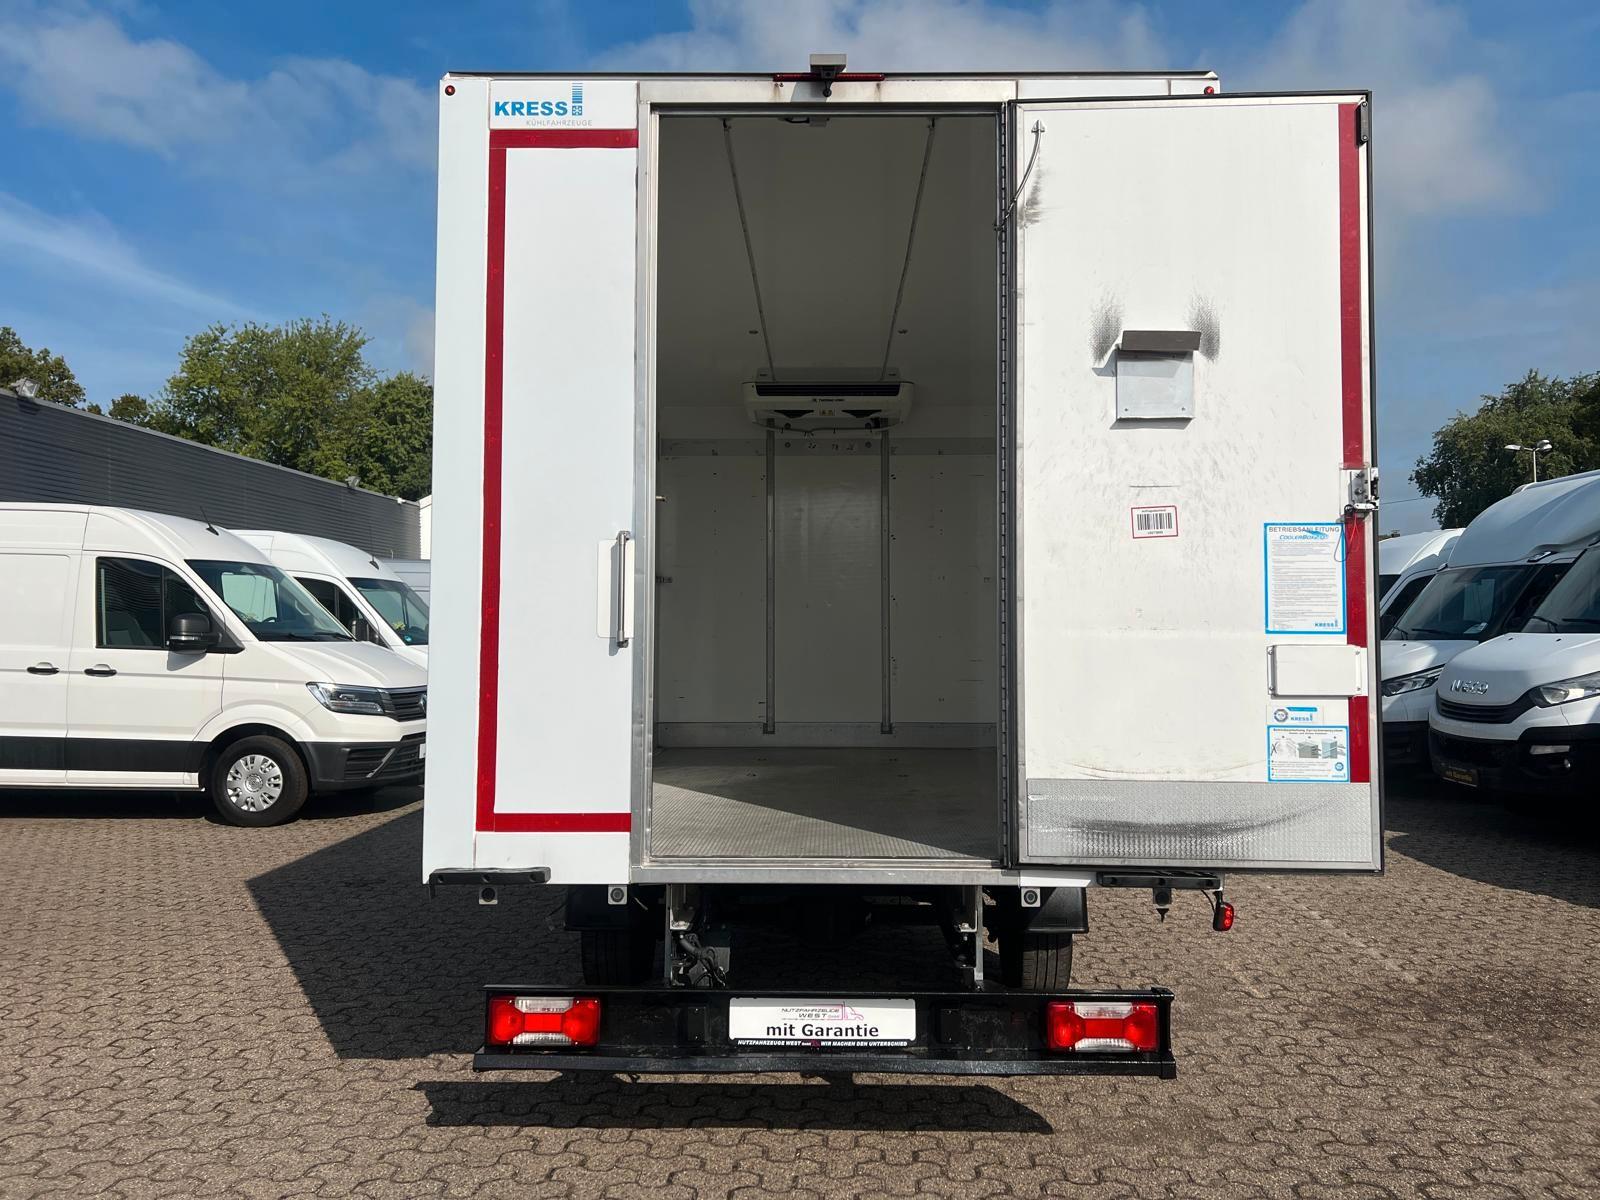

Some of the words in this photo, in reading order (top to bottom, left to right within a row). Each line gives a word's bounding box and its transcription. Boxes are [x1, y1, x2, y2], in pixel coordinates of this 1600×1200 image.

[494, 101, 568, 116] KRESS
[526, 119, 593, 127] KÜHLFAHRZEUGE
[1451, 680, 1489, 695] IVECO
[766, 1023, 796, 1036] mit
[801, 1023, 879, 1037] Garantie
